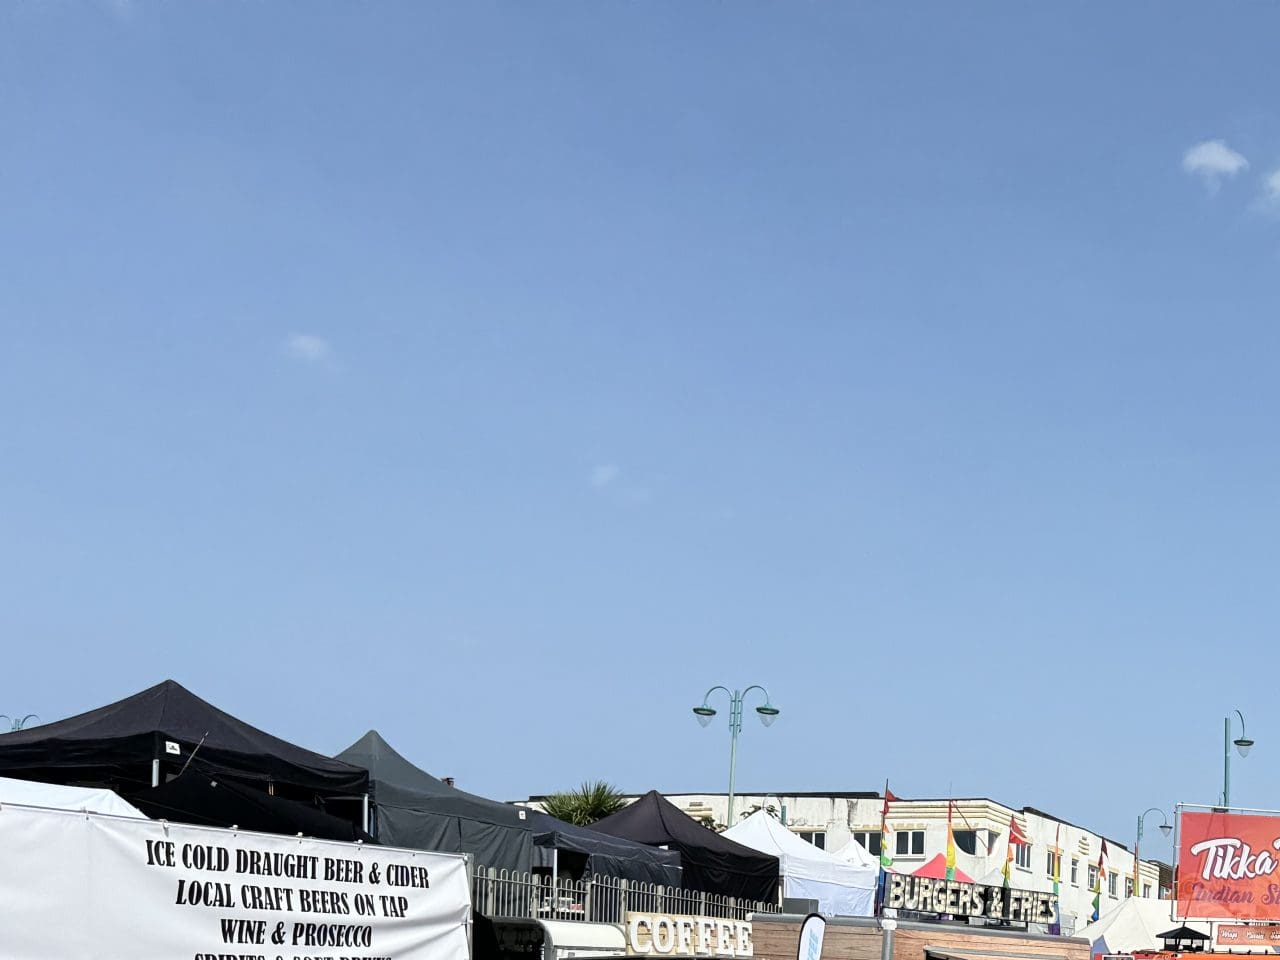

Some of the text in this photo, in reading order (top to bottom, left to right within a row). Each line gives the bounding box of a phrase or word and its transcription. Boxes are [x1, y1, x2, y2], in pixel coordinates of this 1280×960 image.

[146, 839, 430, 888] ICE COLD DRAUGHT BEER & CIDER
[1191, 838, 1278, 880] Tikka
[175, 880, 409, 918] LOCAL CRAFT BEERS ON TAP
[889, 874, 1059, 924] BURGERS & FRIES
[1192, 882, 1254, 904] Indian
[220, 918, 372, 948] WINE & PROSECCO
[630, 916, 754, 958] COFFEE
